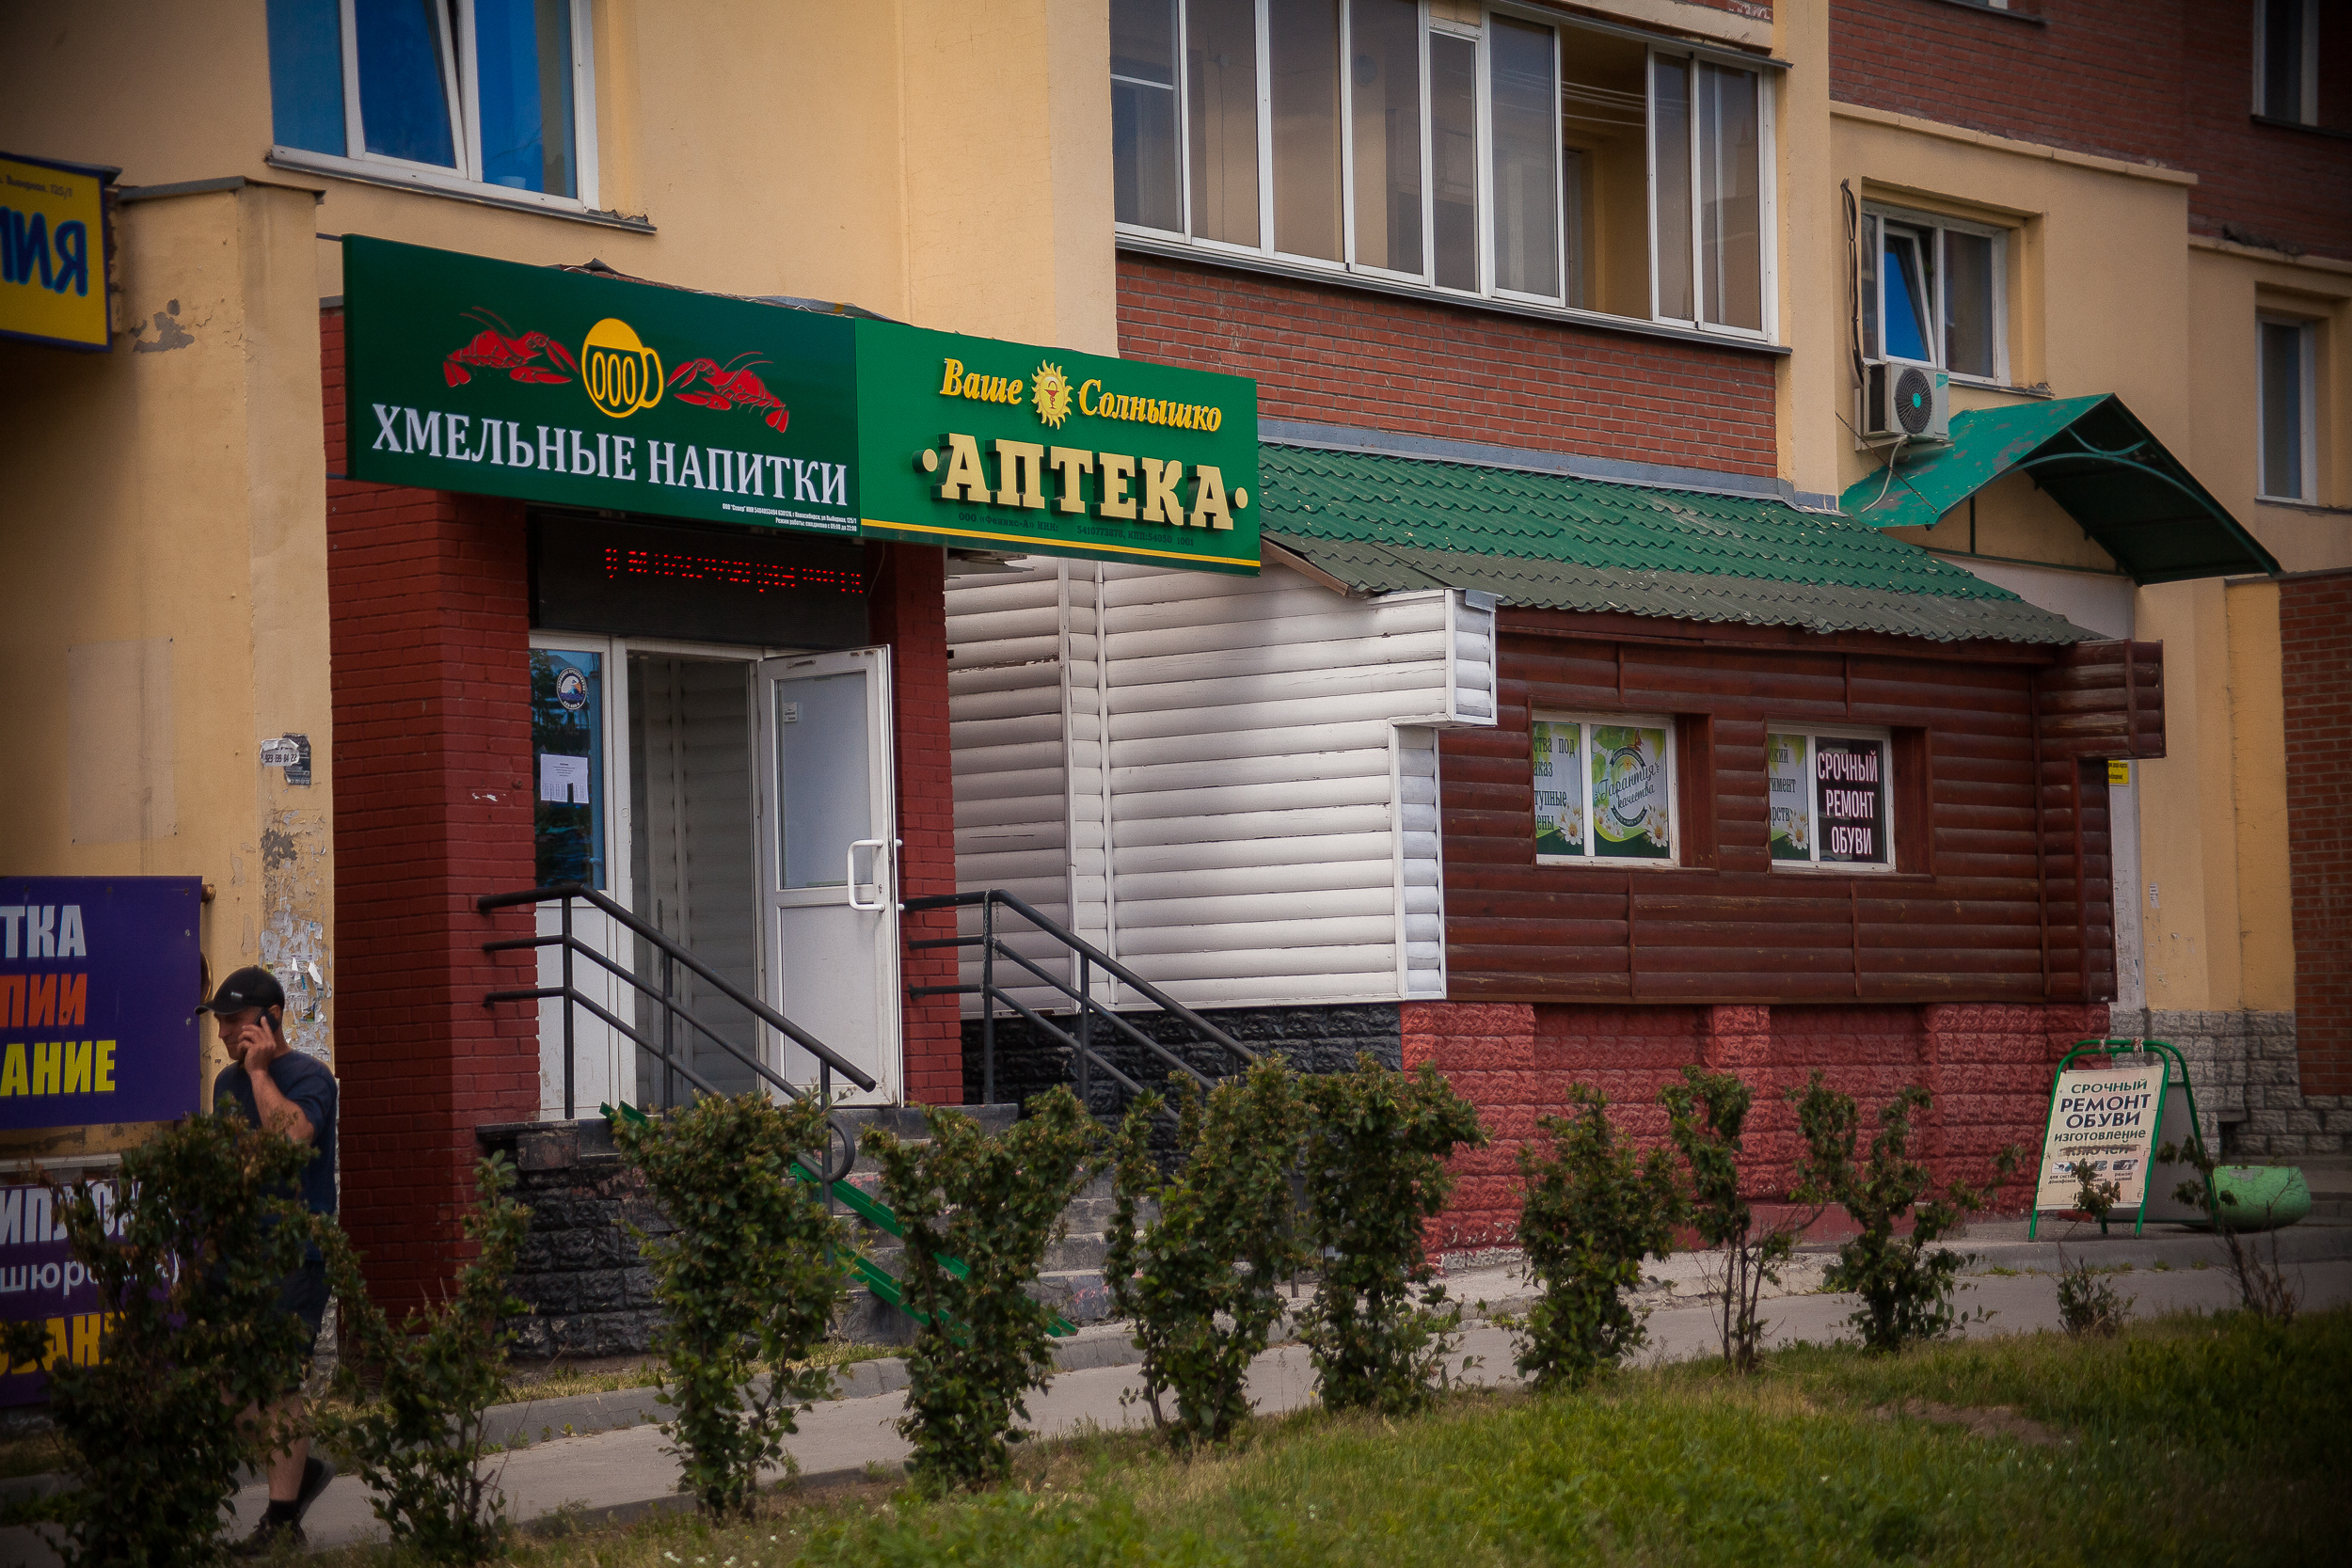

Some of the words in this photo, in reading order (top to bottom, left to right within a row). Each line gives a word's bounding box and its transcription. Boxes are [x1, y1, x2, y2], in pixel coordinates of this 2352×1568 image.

[940, 357, 1023, 404] Ваше
[1078, 378, 1222, 432] Солнышко
[372, 403, 637, 482] ХМЕЛЬНЫЕ
[646, 439, 848, 506] НАПИТКИ
[940, 433, 1234, 531] АПТЕКА
[958, 512, 977, 523] ООО
[1558, 738, 1575, 758] под
[1817, 750, 1878, 783] СРОЧНЫЙ
[1597, 763, 1657, 801] Гарантия
[1617, 781, 1656, 810] качества
[1825, 789, 1874, 818] РЕМОНТ
[1831, 826, 1872, 855] ОБУВИ
[0, 1039, 117, 1097] АНИЕ
[2071, 1078, 2148, 1094] СРОЧНЫЙ
[2059, 1094, 2152, 1113] РЕМОНТ
[2065, 1111, 2141, 1129] ОБУВИ
[2054, 1129, 2147, 1142] изготовление
